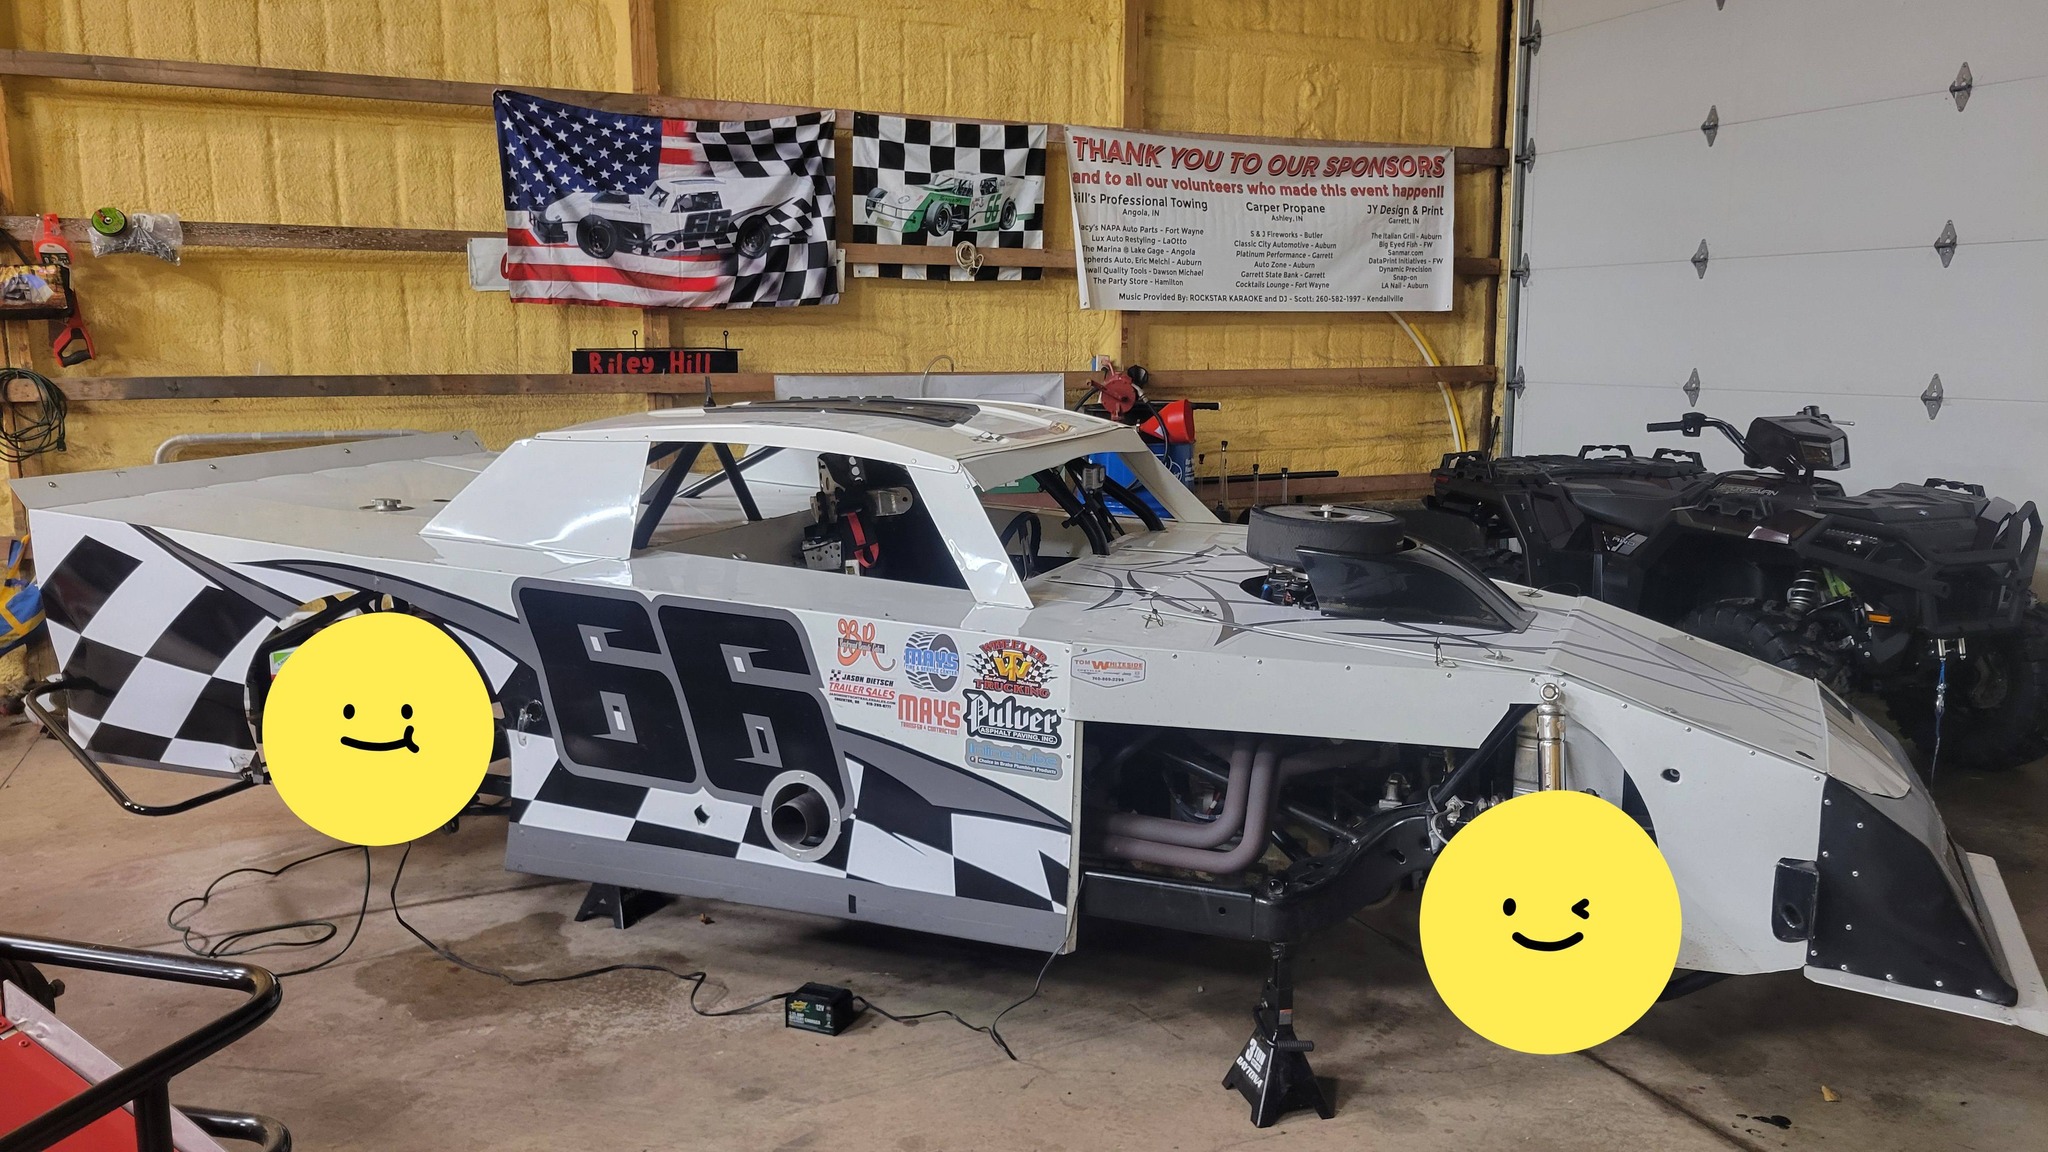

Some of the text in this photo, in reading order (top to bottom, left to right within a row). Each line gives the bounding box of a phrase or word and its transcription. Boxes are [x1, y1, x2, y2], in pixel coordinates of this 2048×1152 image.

[1072, 135, 1446, 179] THANK YOU TO OUR SPONSORS
[1072, 170, 1100, 184] and
[1105, 171, 1122, 186] to
[1125, 172, 1142, 187] all
[1146, 177, 1168, 189] our
[1171, 177, 1244, 194] volunteers
[1247, 183, 1276, 196] who
[1280, 183, 1317, 197] made
[1321, 184, 1347, 197] this
[1350, 184, 1389, 197] event
[984, 193, 1003, 224] 66
[1100, 193, 1168, 207] Professional
[1170, 197, 1208, 212] Towing
[1245, 202, 1326, 215] Carper Propane
[1122, 208, 1160, 217] Angola, IN
[1367, 204, 1444, 217] JY Design & Print
[1271, 215, 1295, 223] Ashley,
[1079, 223, 1205, 237] acy's NAPA Auto Parts Fort Wayne
[1250, 230, 1255, 238] S
[1255, 230, 1261, 238] &
[1371, 232, 1382, 240] The
[1383, 232, 1402, 240] Italian
[1091, 234, 1188, 245] Lux Auto Restyling LaOtto
[1234, 240, 1257, 248] Classic
[1258, 240, 1272, 249] City
[1272, 241, 1310, 249] Automotive
[1378, 241, 1389, 249] Big
[1096, 245, 1121, 253] Marina
[1130, 247, 1146, 255] Lake
[1147, 248, 1165, 256] Gage
[1170, 248, 1196, 257] Angola
[1236, 250, 1265, 258] Platinum
[1266, 251, 1307, 259] Performance
[1113, 256, 1134, 265] Auto,
[1135, 257, 1147, 265] Eric
[1176, 258, 1202, 266] Auburn
[1292, 261, 1316, 269] Auburn
[1103, 266, 1129, 276] Quality
[1130, 267, 1148, 275] Tools
[1152, 268, 1178, 276] Dawson
[1178, 269, 1204, 277] Michael
[1283, 271, 1299, 279] Bank
[1378, 265, 1405, 274] Dynamic
[1093, 277, 1107, 285] The
[1108, 277, 1128, 287] Party
[1154, 278, 1184, 286] Hamilton
[1266, 281, 1290, 290] Lounge
[1294, 281, 1308, 289] Fort
[1308, 282, 1330, 290] Wayne
[1118, 293, 1142, 301] Music
[1177, 294, 1189, 303] By:
[1190, 294, 1227, 302] ROCKSTAR
[1294, 295, 1315, 303] Scott:
[1316, 295, 1361, 303] 260-582-1997
[588, 350, 711, 374] Riley Hill
[979, 638, 1048, 664] WHEELER
[904, 647, 959, 671] MAYS
[1091, 660, 1144, 670] WHITESIDE
[920, 666, 939, 674] SERVICE
[939, 668, 959, 676] CENTER
[842, 673, 894, 687] JASON DIETSCH
[829, 682, 865, 694] TRAILER
[866, 687, 896, 700] SALES
[973, 678, 1051, 699] TRUCKING
[514, 580, 850, 812] 66
[898, 693, 961, 729] MAYS
[966, 692, 1057, 734] Pulver
[980, 727, 1011, 737] ASPHALT
[1012, 732, 1040, 742] PAVING,
[1245, 1037, 1258, 1062] 3
[1236, 1055, 1264, 1088] DAYTONA
